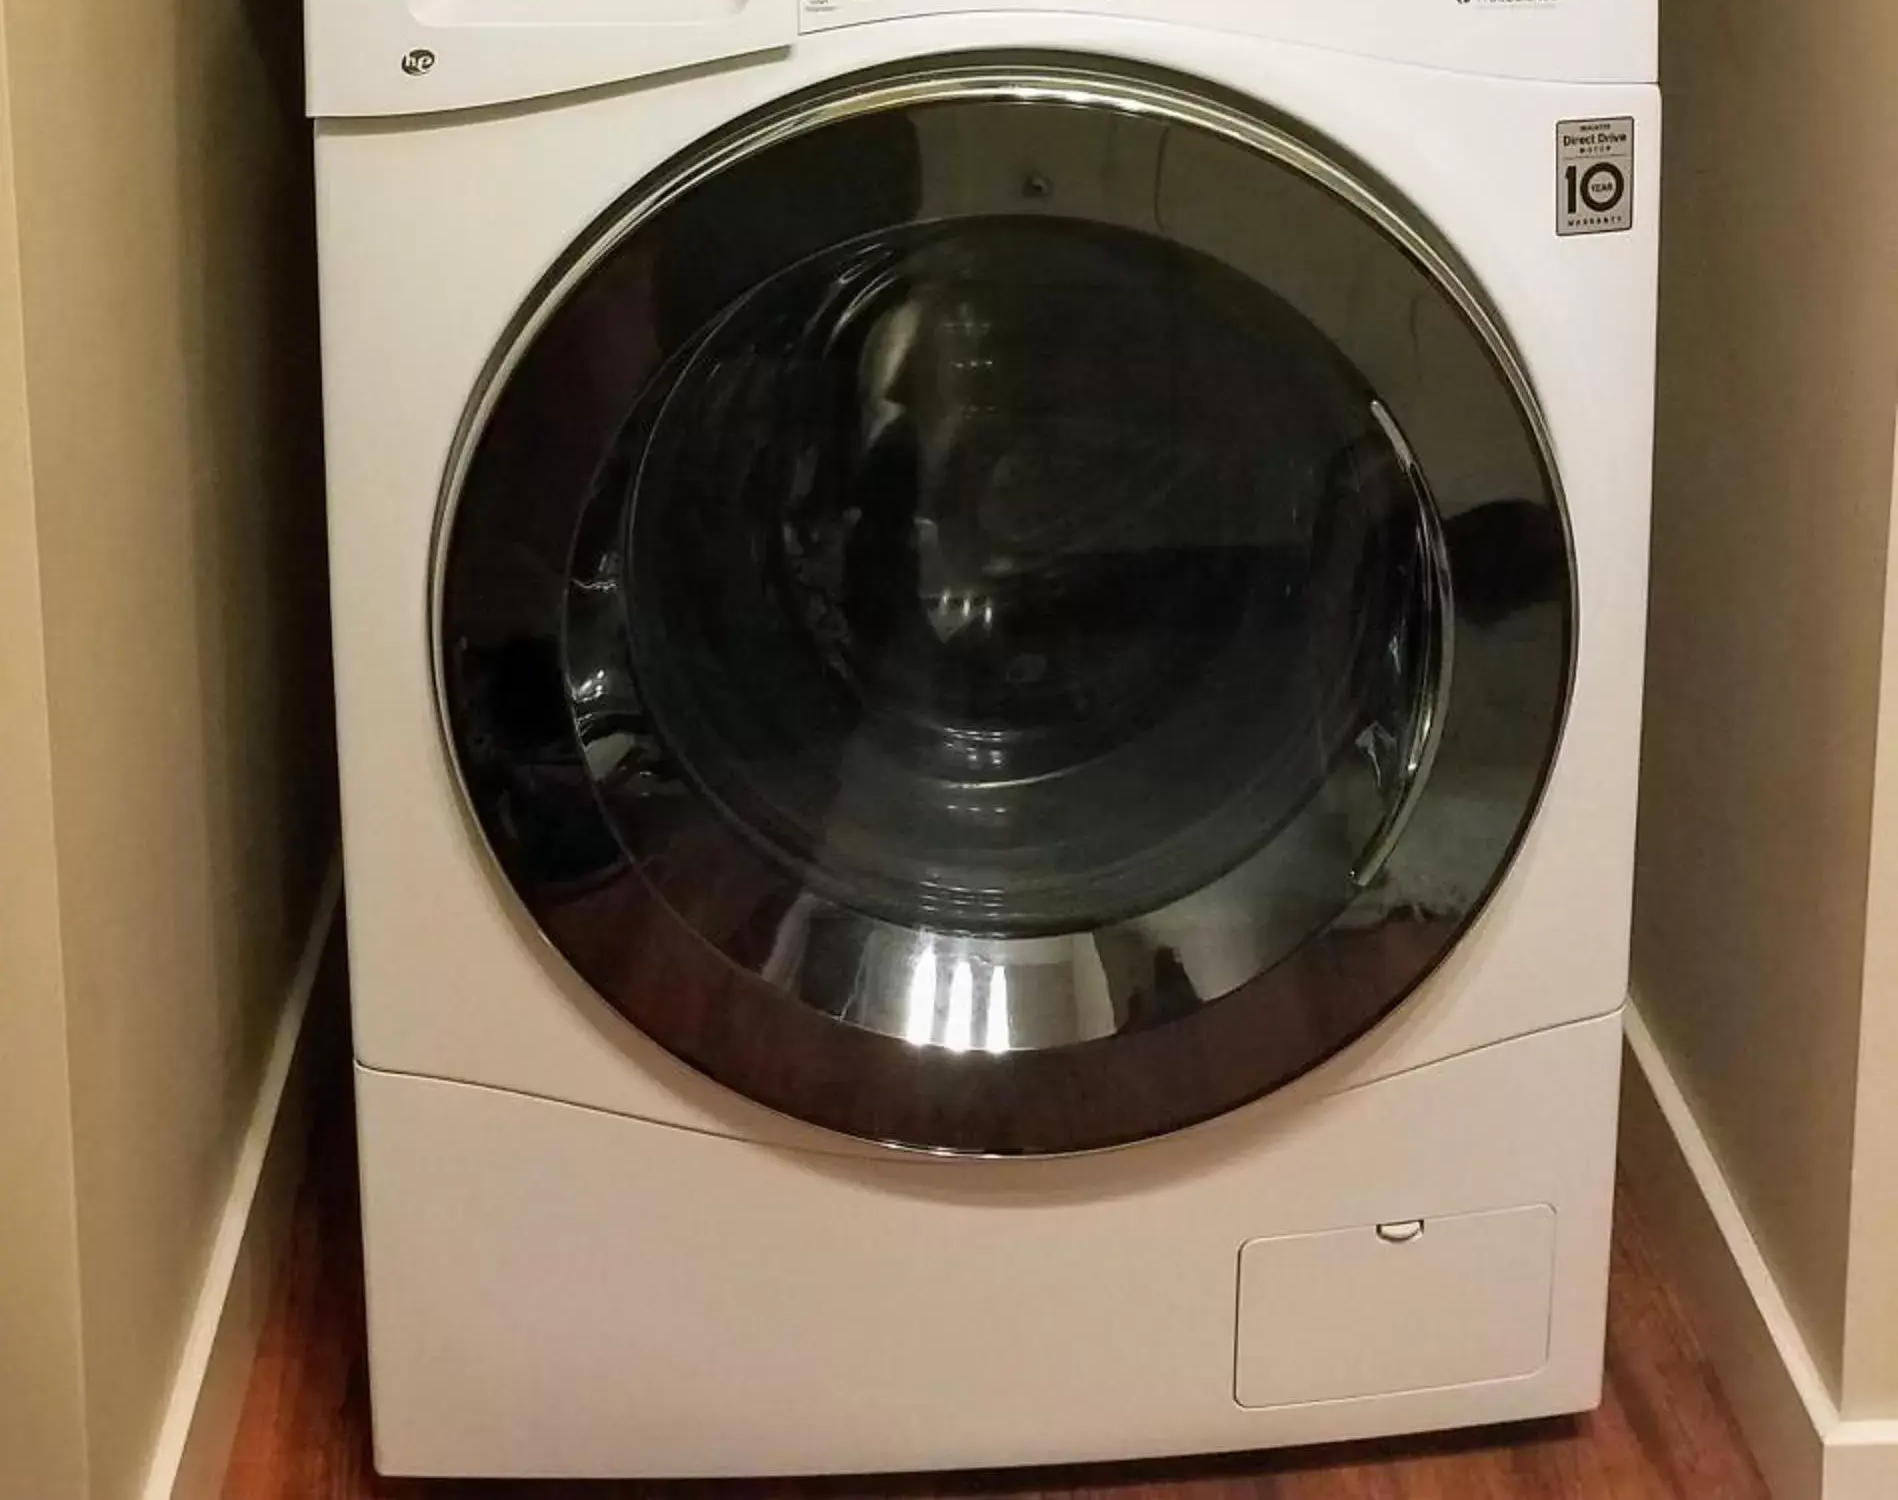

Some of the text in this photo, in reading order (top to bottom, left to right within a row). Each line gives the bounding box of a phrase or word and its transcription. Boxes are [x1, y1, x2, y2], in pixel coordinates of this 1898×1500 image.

[1563, 133, 1626, 146] Direct Drive
[1565, 162, 1624, 213] 10
[1591, 182, 1613, 192] YEAR
